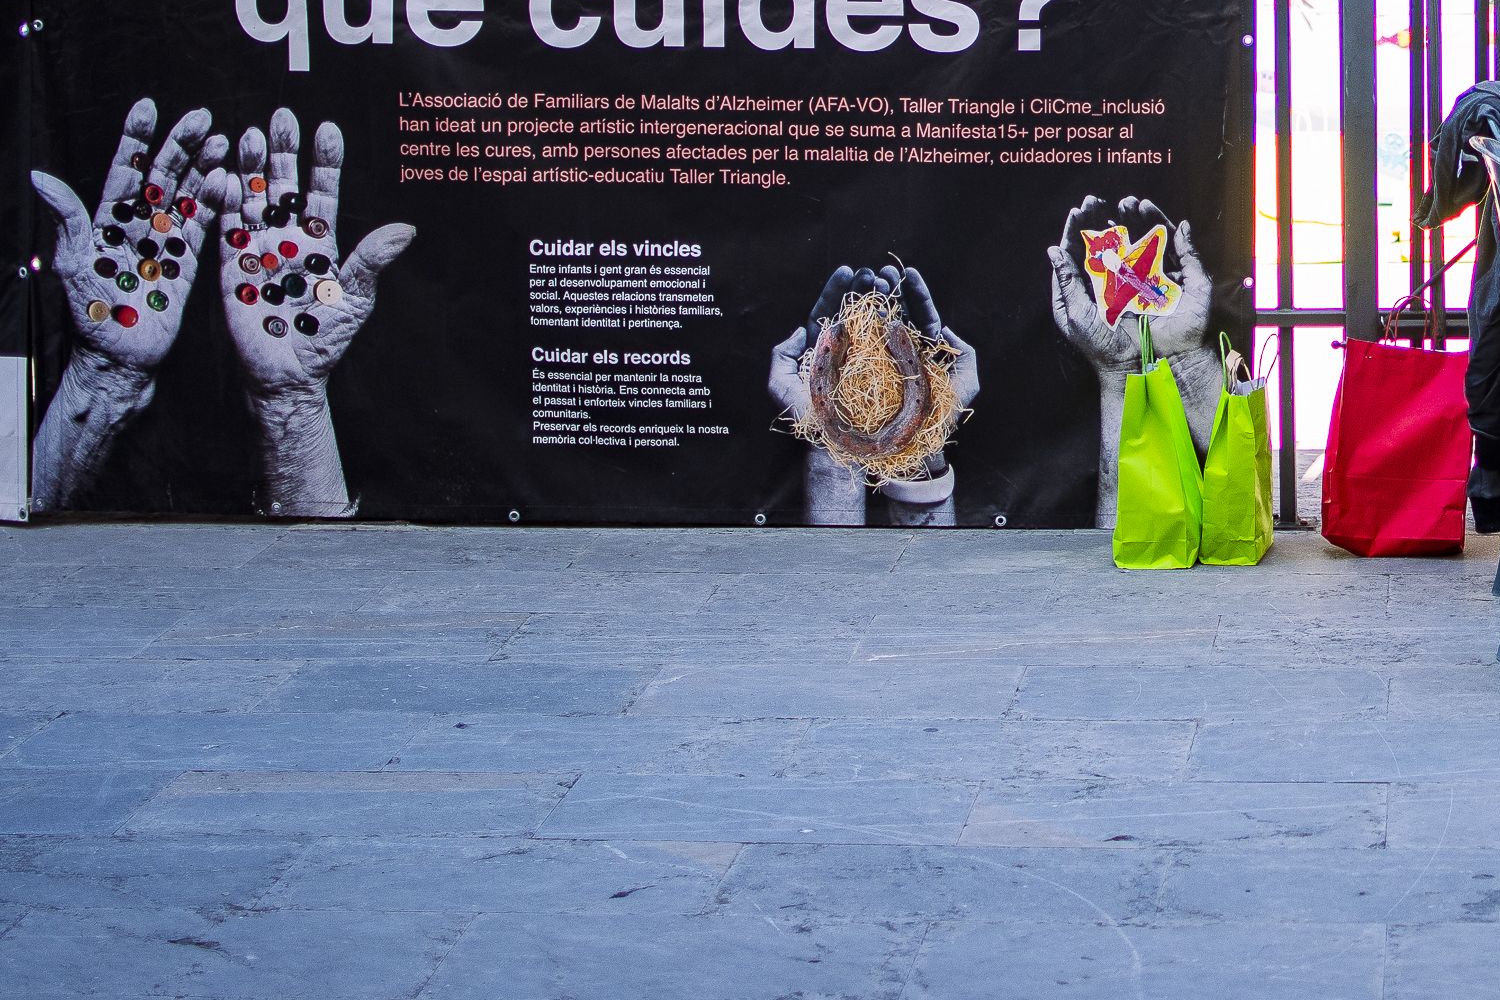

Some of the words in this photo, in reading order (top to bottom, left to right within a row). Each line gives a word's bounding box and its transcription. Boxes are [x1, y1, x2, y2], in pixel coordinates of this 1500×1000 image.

[399, 92, 502, 108] L’Associació
[507, 93, 528, 108] de
[534, 93, 610, 109] Familiars
[614, 94, 635, 110] de
[641, 94, 700, 110] Malalts
[705, 95, 804, 112] d’Alzheimer
[809, 96, 894, 116] (AFA-VO),
[899, 97, 944, 114] Taller
[948, 98, 1015, 118] Triangle
[1021, 99, 1024, 114] i
[1030, 98, 1165, 116] CliCme_inclusió
[400, 116, 429, 132] han
[436, 117, 476, 133] ideat
[481, 121, 502, 133] un
[507, 118, 574, 136] projecte
[580, 118, 635, 134] artístic
[640, 119, 783, 139] intergeneracional
[788, 124, 820, 140] que
[825, 124, 844, 137] se
[850, 125, 896, 138] suma
[901, 126, 912, 138] a
[916, 122, 1029, 139] Manifesta15+
[1034, 126, 1062, 142] per
[1067, 126, 1114, 142] posar
[1119, 123, 1133, 139] al
[400, 142, 450, 156] centre
[456, 142, 480, 158] les
[485, 145, 536, 160] cures,
[542, 142, 578, 158] amb
[584, 146, 660, 162] persones
[666, 144, 747, 160] afectades
[752, 148, 780, 164] per
[784, 145, 799, 161] la
[804, 146, 869, 162] malaltia
[874, 146, 894, 162] de
[900, 147, 994, 166] l’Alzheimer,
[1000, 148, 1092, 163] cuidadores
[1098, 148, 1101, 163] i
[1107, 148, 1162, 164] infants
[1168, 148, 1171, 164] i
[400, 164, 444, 183] joves
[448, 166, 468, 181] de
[474, 167, 526, 186] l’espai
[532, 166, 664, 183] artístic-educatiu
[669, 168, 715, 184] Taller
[719, 169, 790, 189] Triangle.
[529, 239, 594, 256] Cuidar
[599, 240, 628, 256] els
[632, 240, 702, 258] vincles
[529, 264, 556, 274] Entre
[558, 264, 592, 274] infants
[594, 264, 597, 274] i
[599, 265, 622, 277] gent
[624, 266, 647, 277] gran
[649, 264, 662, 275] és
[664, 265, 710, 276] essencial
[529, 278, 546, 288] per
[548, 277, 557, 287] al
[559, 277, 648, 290] desenvolupament
[649, 278, 700, 289] emocional
[702, 279, 706, 288] i
[530, 290, 560, 300] social.
[562, 290, 610, 302] Aquestes
[612, 291, 656, 302] relacions
[658, 292, 714, 302] transmeten
[530, 316, 579, 327] fomentant
[581, 317, 620, 328] identitat
[622, 318, 626, 327] i
[628, 318, 682, 330] pertinença.
[532, 346, 588, 364] Cuidar
[593, 349, 619, 364] els
[624, 350, 691, 365] records
[532, 367, 546, 379] És
[547, 371, 593, 381] essencial
[595, 374, 612, 383] per
[614, 372, 658, 382] mantenir
[660, 372, 669, 382] la
[671, 374, 702, 383] nostra
[532, 382, 571, 393] identitat
[572, 384, 576, 393] i
[578, 382, 616, 395] història.
[619, 385, 639, 395] Ens
[640, 386, 686, 396] connecta
[688, 386, 711, 396] amb
[532, 409, 591, 419] comunitaris.
[533, 421, 581, 432] Preservar
[582, 422, 598, 432] els
[600, 424, 636, 434] records
[638, 424, 684, 436] enriqueix
[686, 424, 696, 434] la
[698, 425, 729, 434] nostra
[532, 434, 576, 444] memòria
[578, 435, 626, 446] col·lectiva
[628, 436, 632, 446] i
[634, 434, 680, 448] personal.
